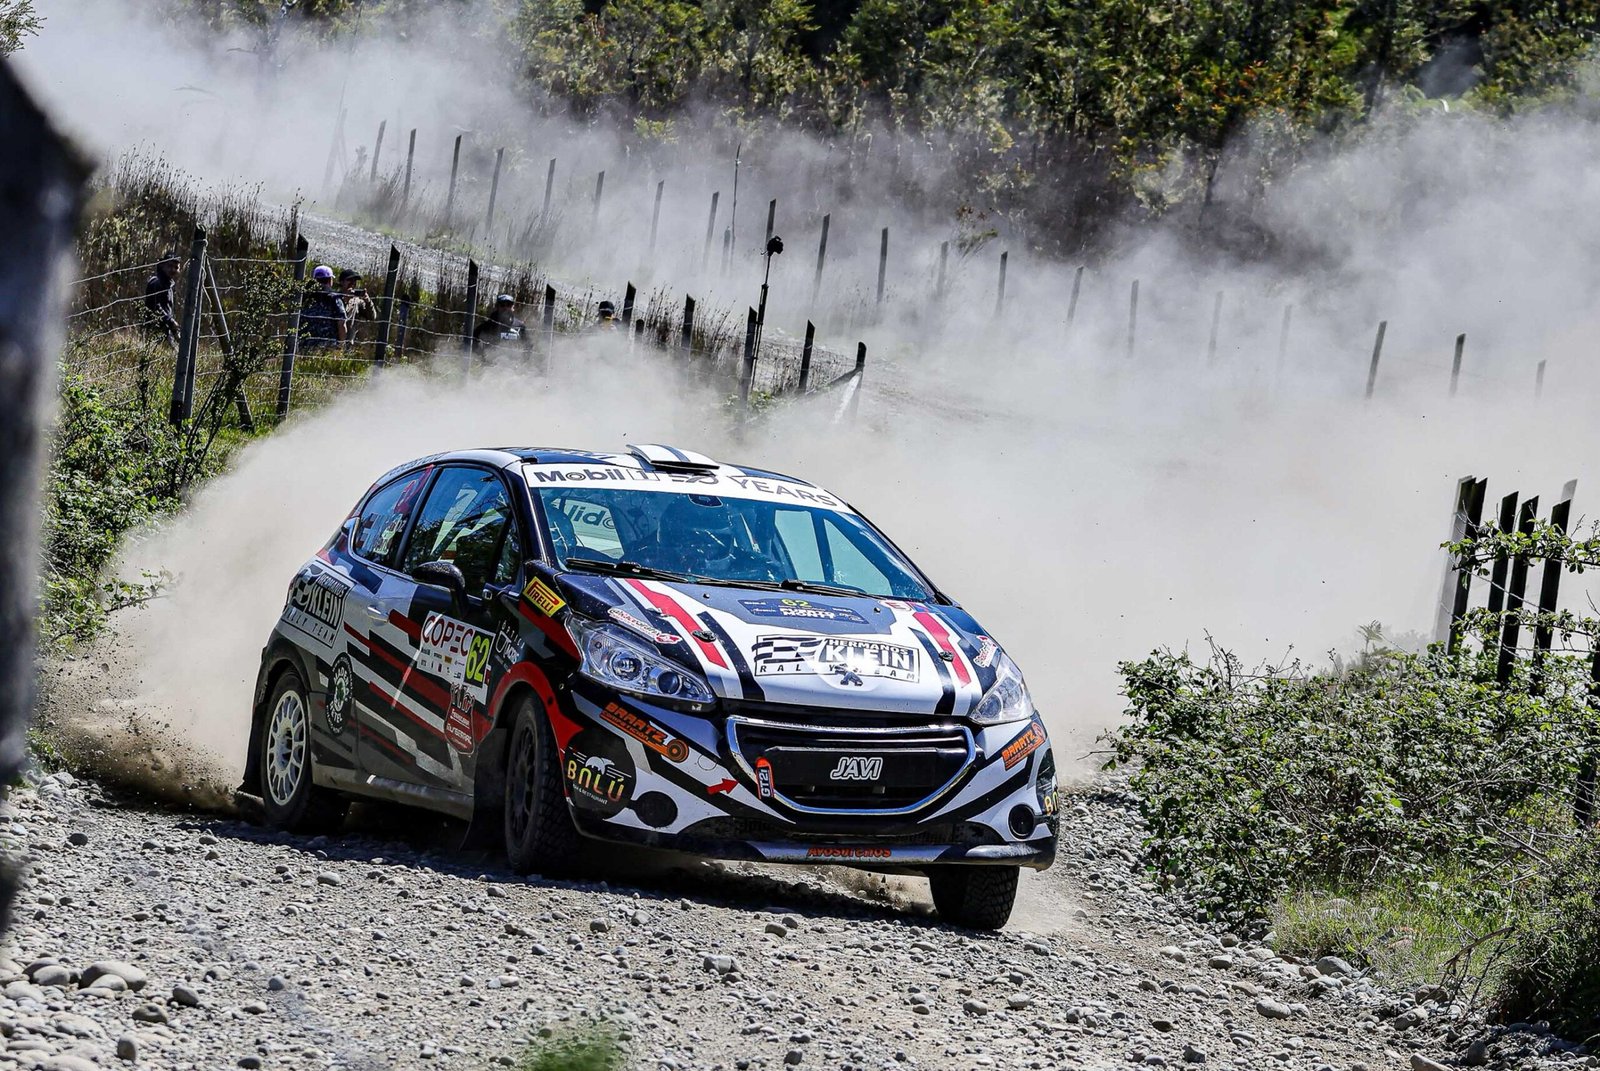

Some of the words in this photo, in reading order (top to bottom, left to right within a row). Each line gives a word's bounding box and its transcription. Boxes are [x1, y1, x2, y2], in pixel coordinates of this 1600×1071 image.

[533, 468, 626, 483] Mobil
[727, 475, 838, 507] YEARS
[308, 584, 342, 627] KLEIN
[527, 581, 560, 613] PIRELLI
[782, 599, 812, 608] 62
[312, 622, 336, 643] TEAM
[422, 615, 474, 657] COPEC
[466, 634, 490, 682] 62
[825, 645, 910, 672] KLEIN
[828, 639, 909, 656] HERMANOS
[760, 664, 835, 674] RALY
[830, 757, 882, 780] JAVI
